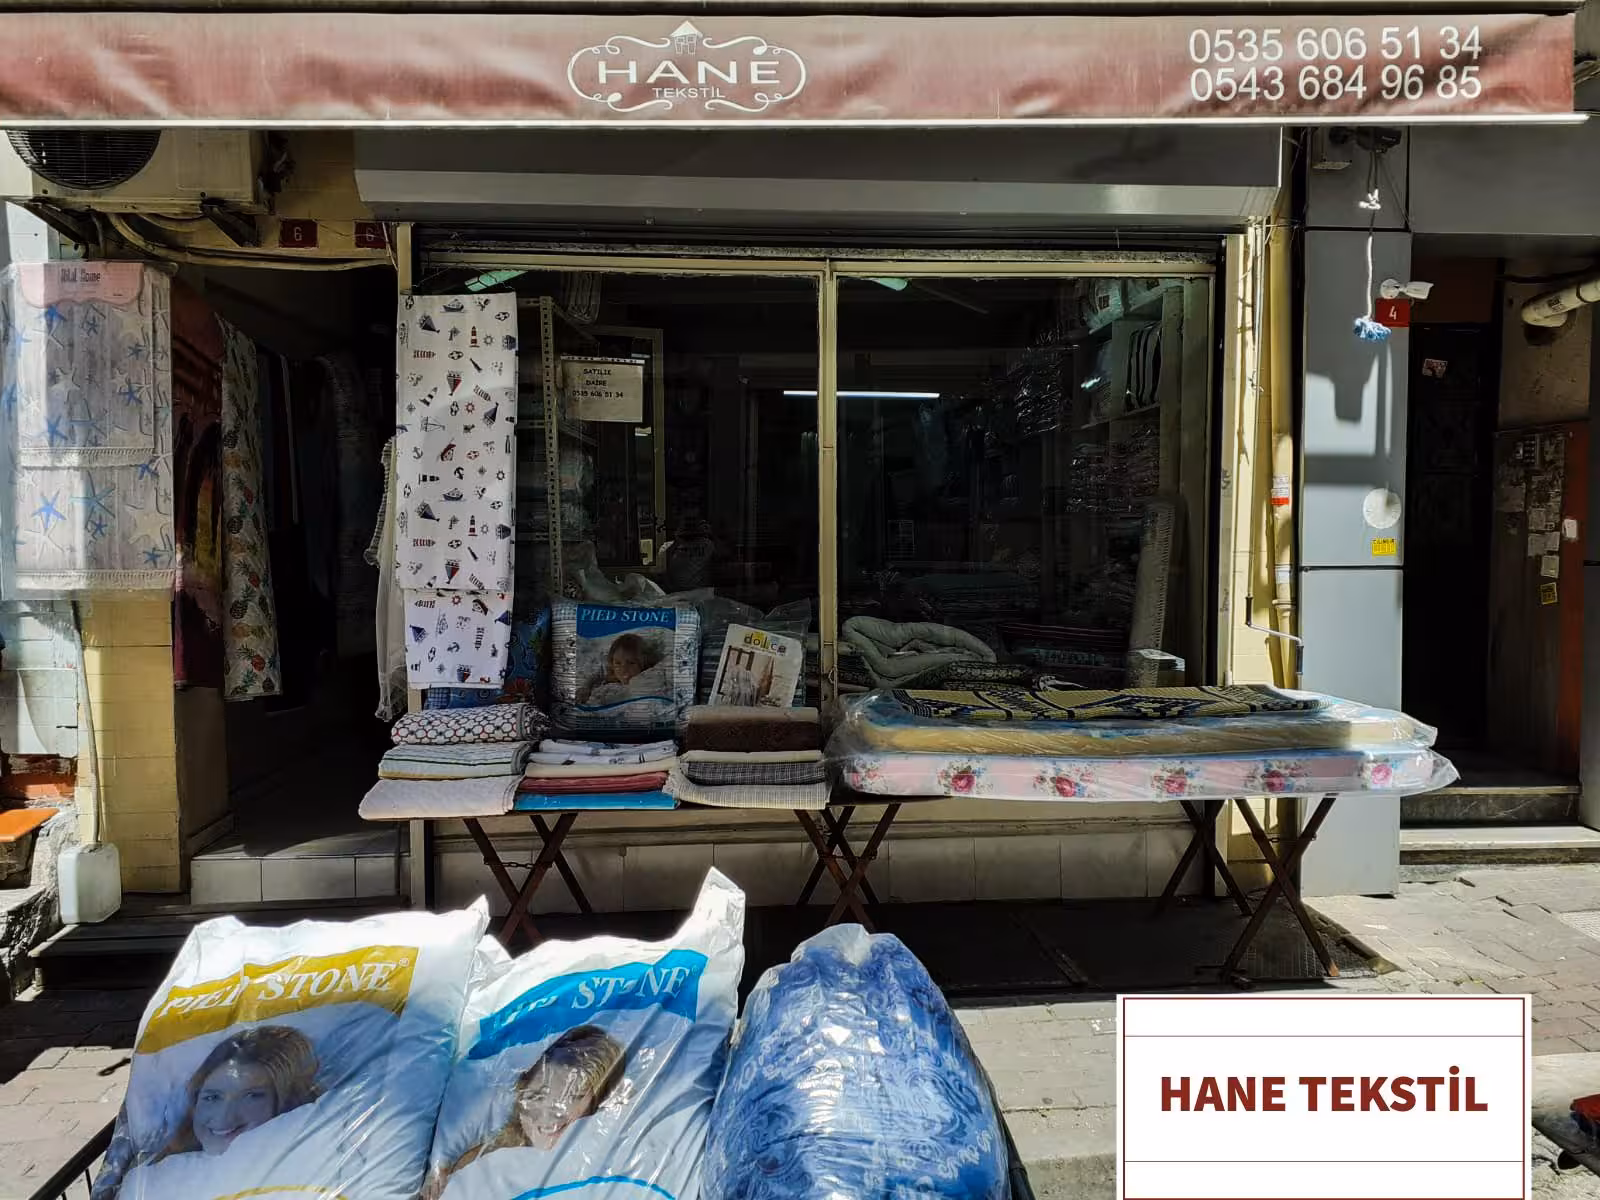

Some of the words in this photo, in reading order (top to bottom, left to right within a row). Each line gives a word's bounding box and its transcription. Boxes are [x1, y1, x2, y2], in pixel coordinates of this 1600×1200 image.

[1189, 28, 1284, 63] 0535
[1296, 27, 1367, 61] 606
[1380, 26, 1421, 60] 51
[1439, 25, 1483, 60] 34
[598, 60, 780, 84] HANE
[1190, 65, 1285, 101] 0543
[1299, 64, 1367, 100] 684
[1381, 64, 1425, 100] 96
[1436, 64, 1482, 99] 85
[652, 86, 726, 99] TEKSTİL
[294, 226, 303, 242] 6
[1389, 305, 1397, 320] 4
[580, 607, 617, 622] PIED
[620, 609, 669, 624] STONE
[743, 630, 787, 654] dolce
[258, 962, 397, 1001] STONE
